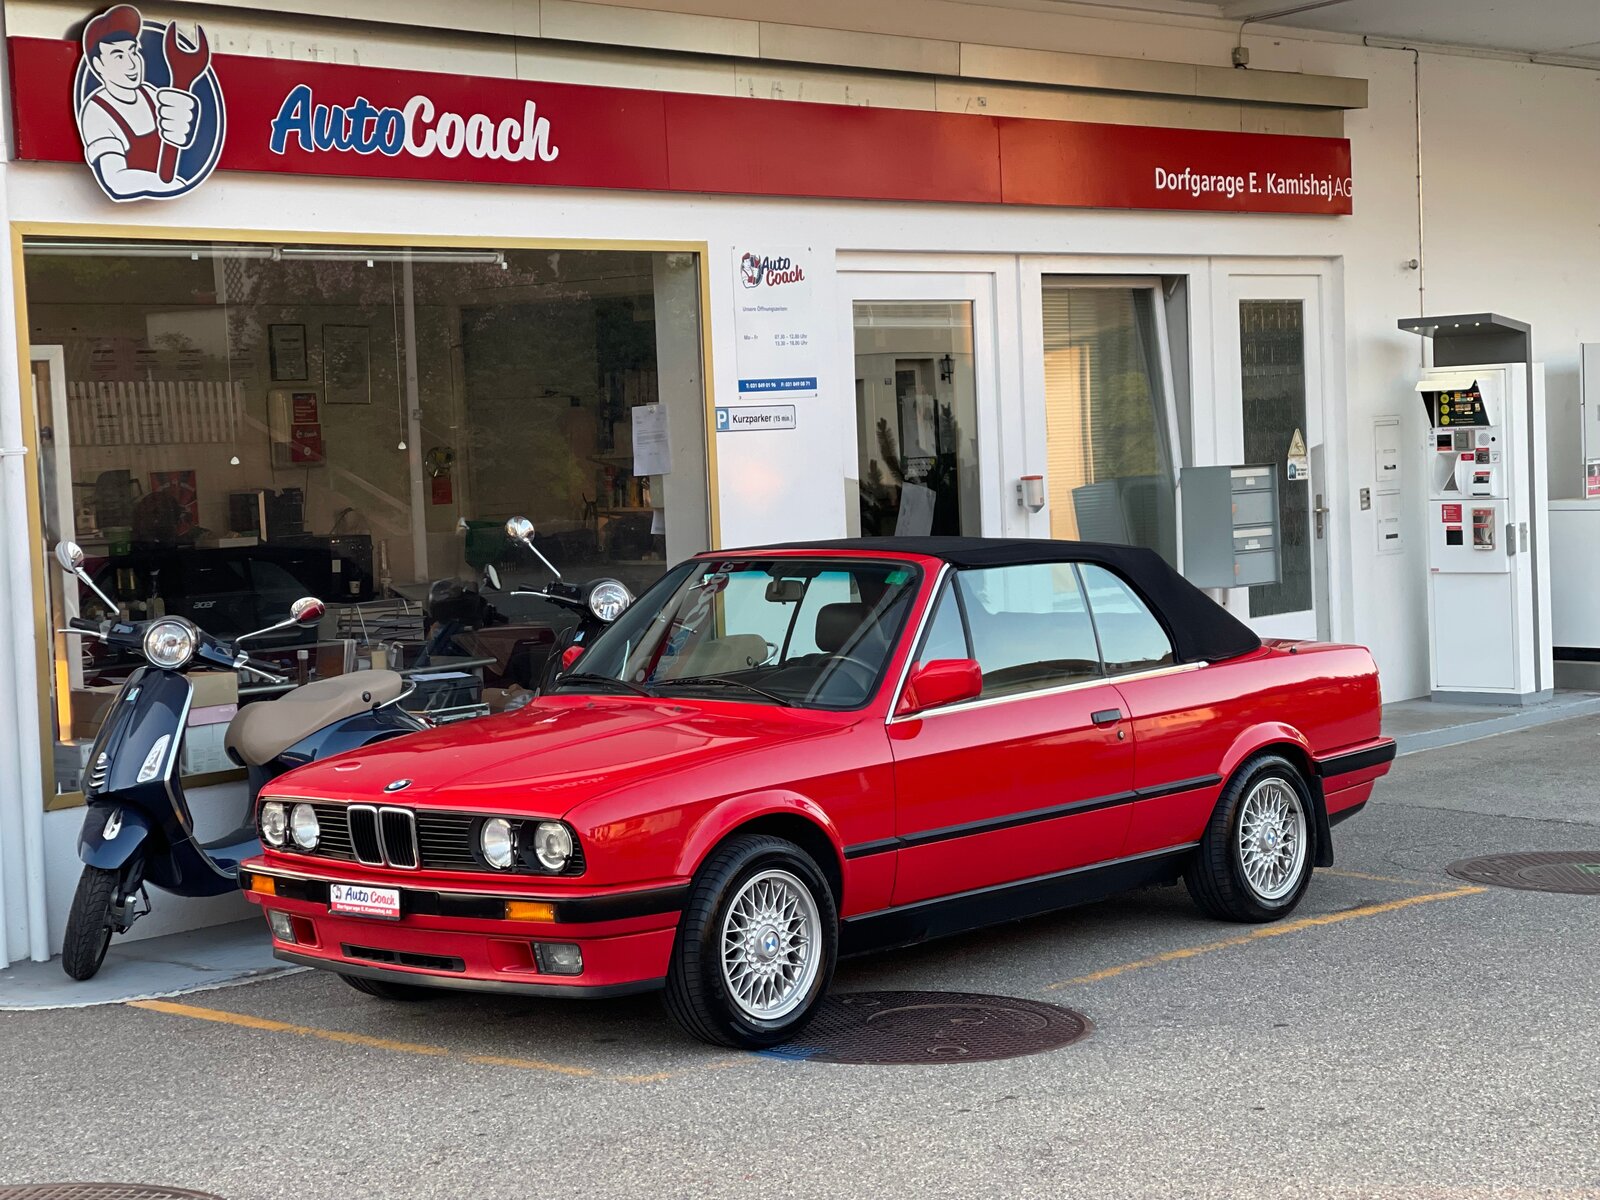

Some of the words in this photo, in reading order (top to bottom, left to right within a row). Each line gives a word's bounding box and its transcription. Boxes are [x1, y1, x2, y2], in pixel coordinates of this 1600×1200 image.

[1155, 167, 1244, 198] Dorfgarage
[1249, 172, 1262, 193] E.
[761, 256, 791, 274] Auto
[766, 264, 805, 286] Coach
[716, 410, 727, 429] P
[733, 414, 772, 425] Kurzparker
[193, 600, 217, 609] acer
[345, 887, 369, 902] Auto
[370, 891, 395, 905] Coach
